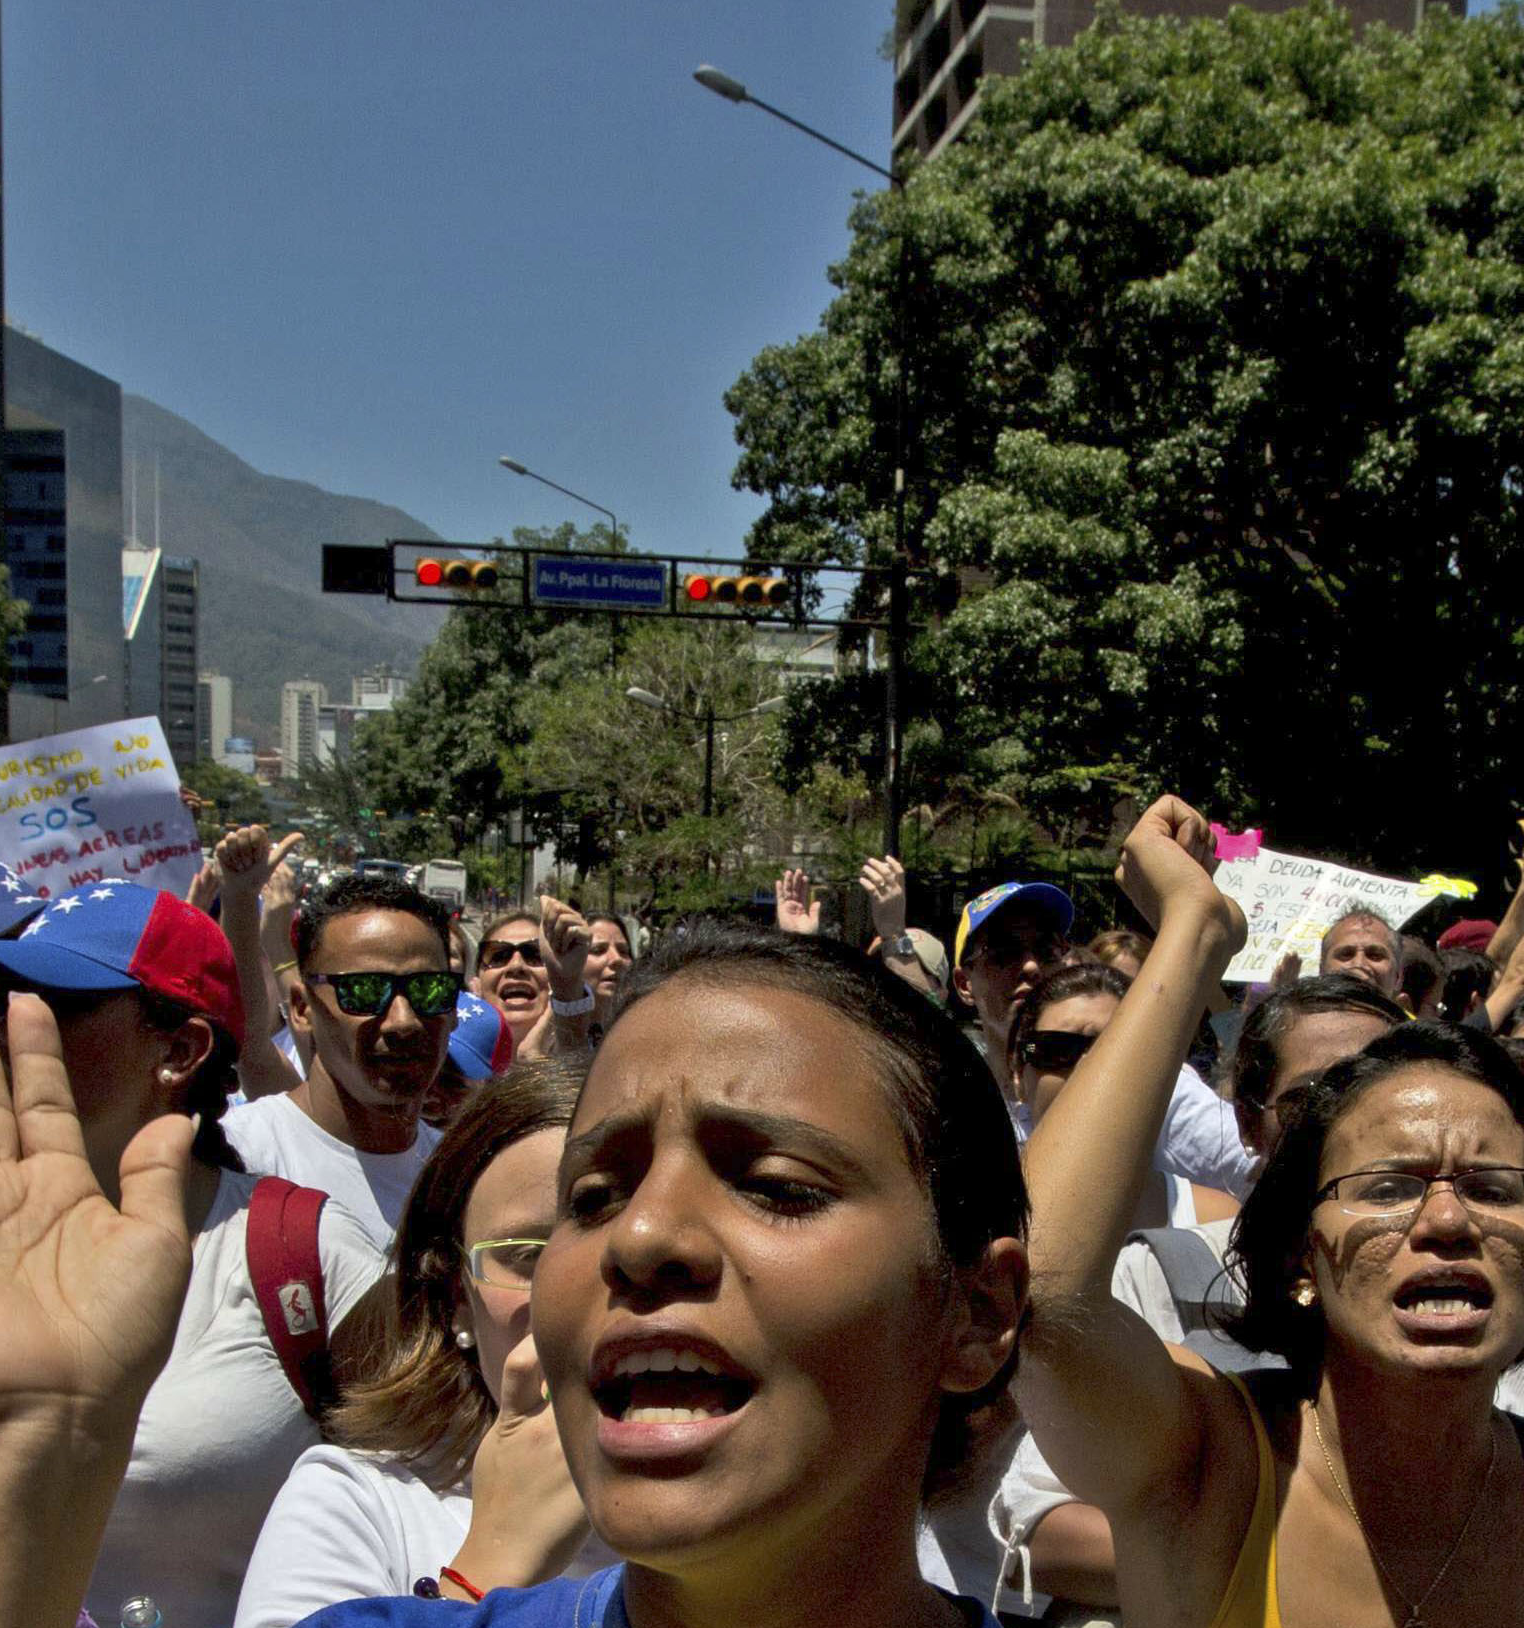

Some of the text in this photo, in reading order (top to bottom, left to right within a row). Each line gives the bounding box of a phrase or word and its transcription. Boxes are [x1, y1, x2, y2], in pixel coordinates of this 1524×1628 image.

[539, 570, 556, 585] Av.
[593, 573, 608, 587] La
[612, 575, 661, 591] Floresta
[19, 796, 97, 841] SOS
[1269, 859, 1324, 879] DEUDA
